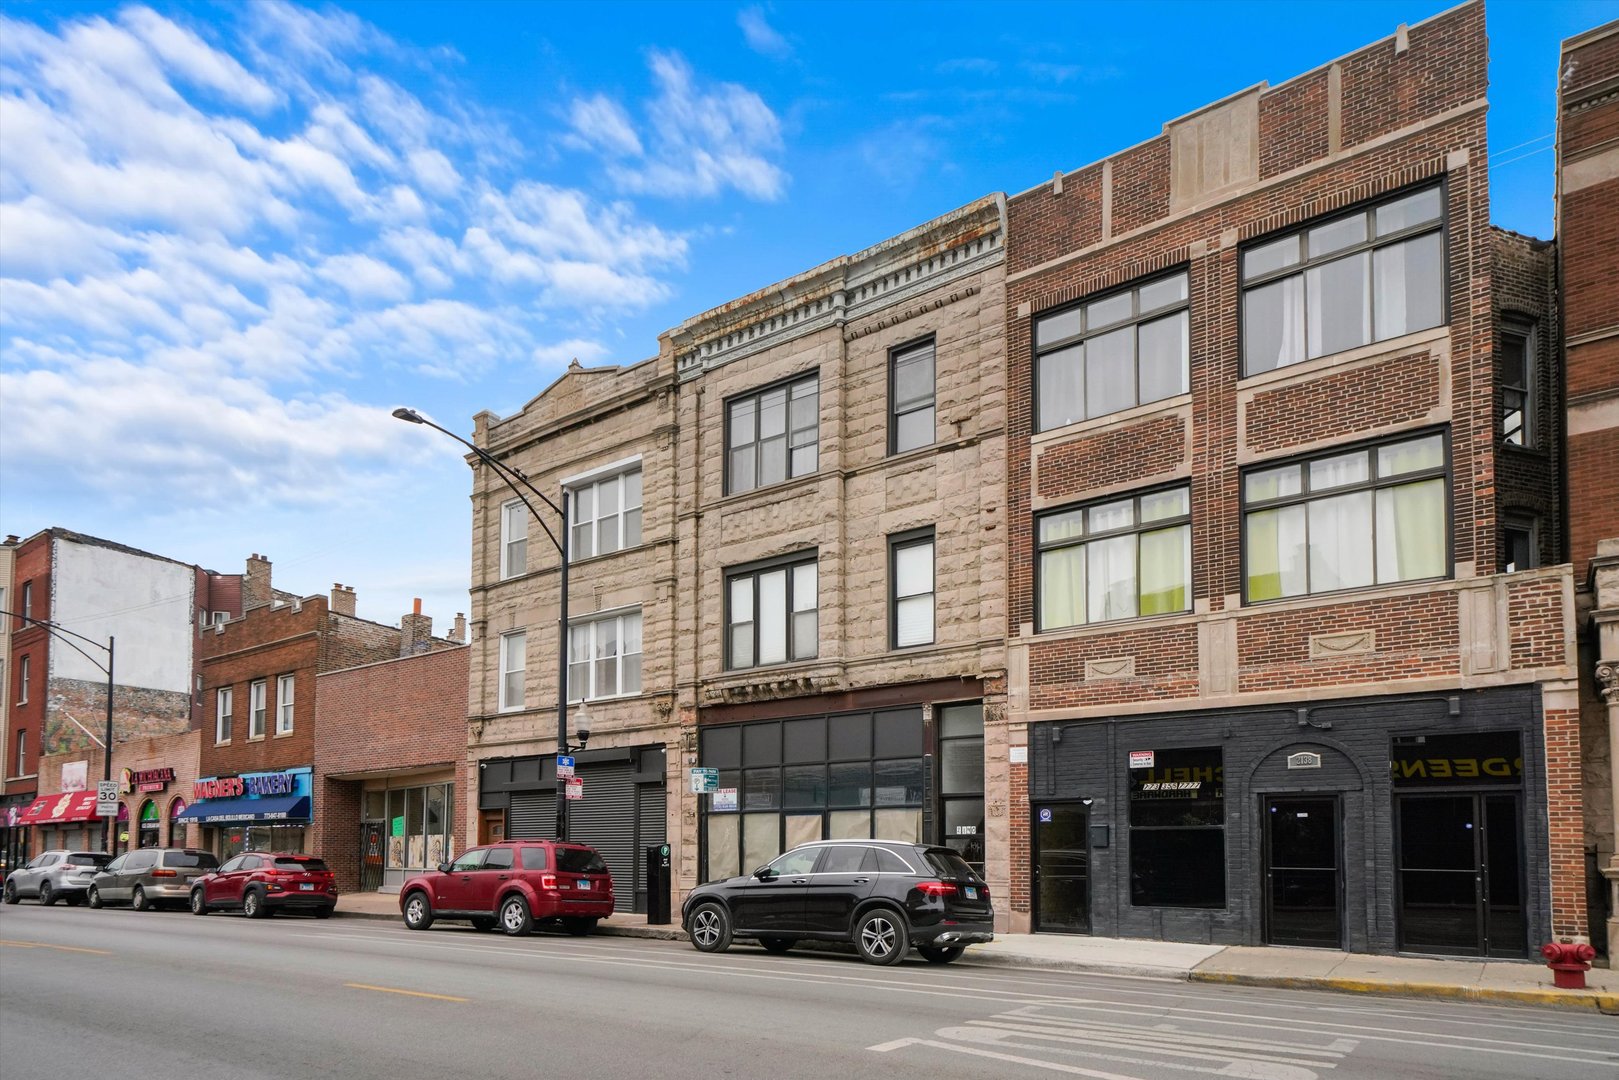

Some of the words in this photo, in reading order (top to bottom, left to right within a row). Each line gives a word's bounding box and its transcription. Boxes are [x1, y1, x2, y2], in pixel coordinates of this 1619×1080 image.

[1296, 755, 1312, 765] 2138
[194, 777, 243, 800] WAGNER'S
[248, 773, 293, 795] BAKERY
[100, 792, 116, 800] 30
